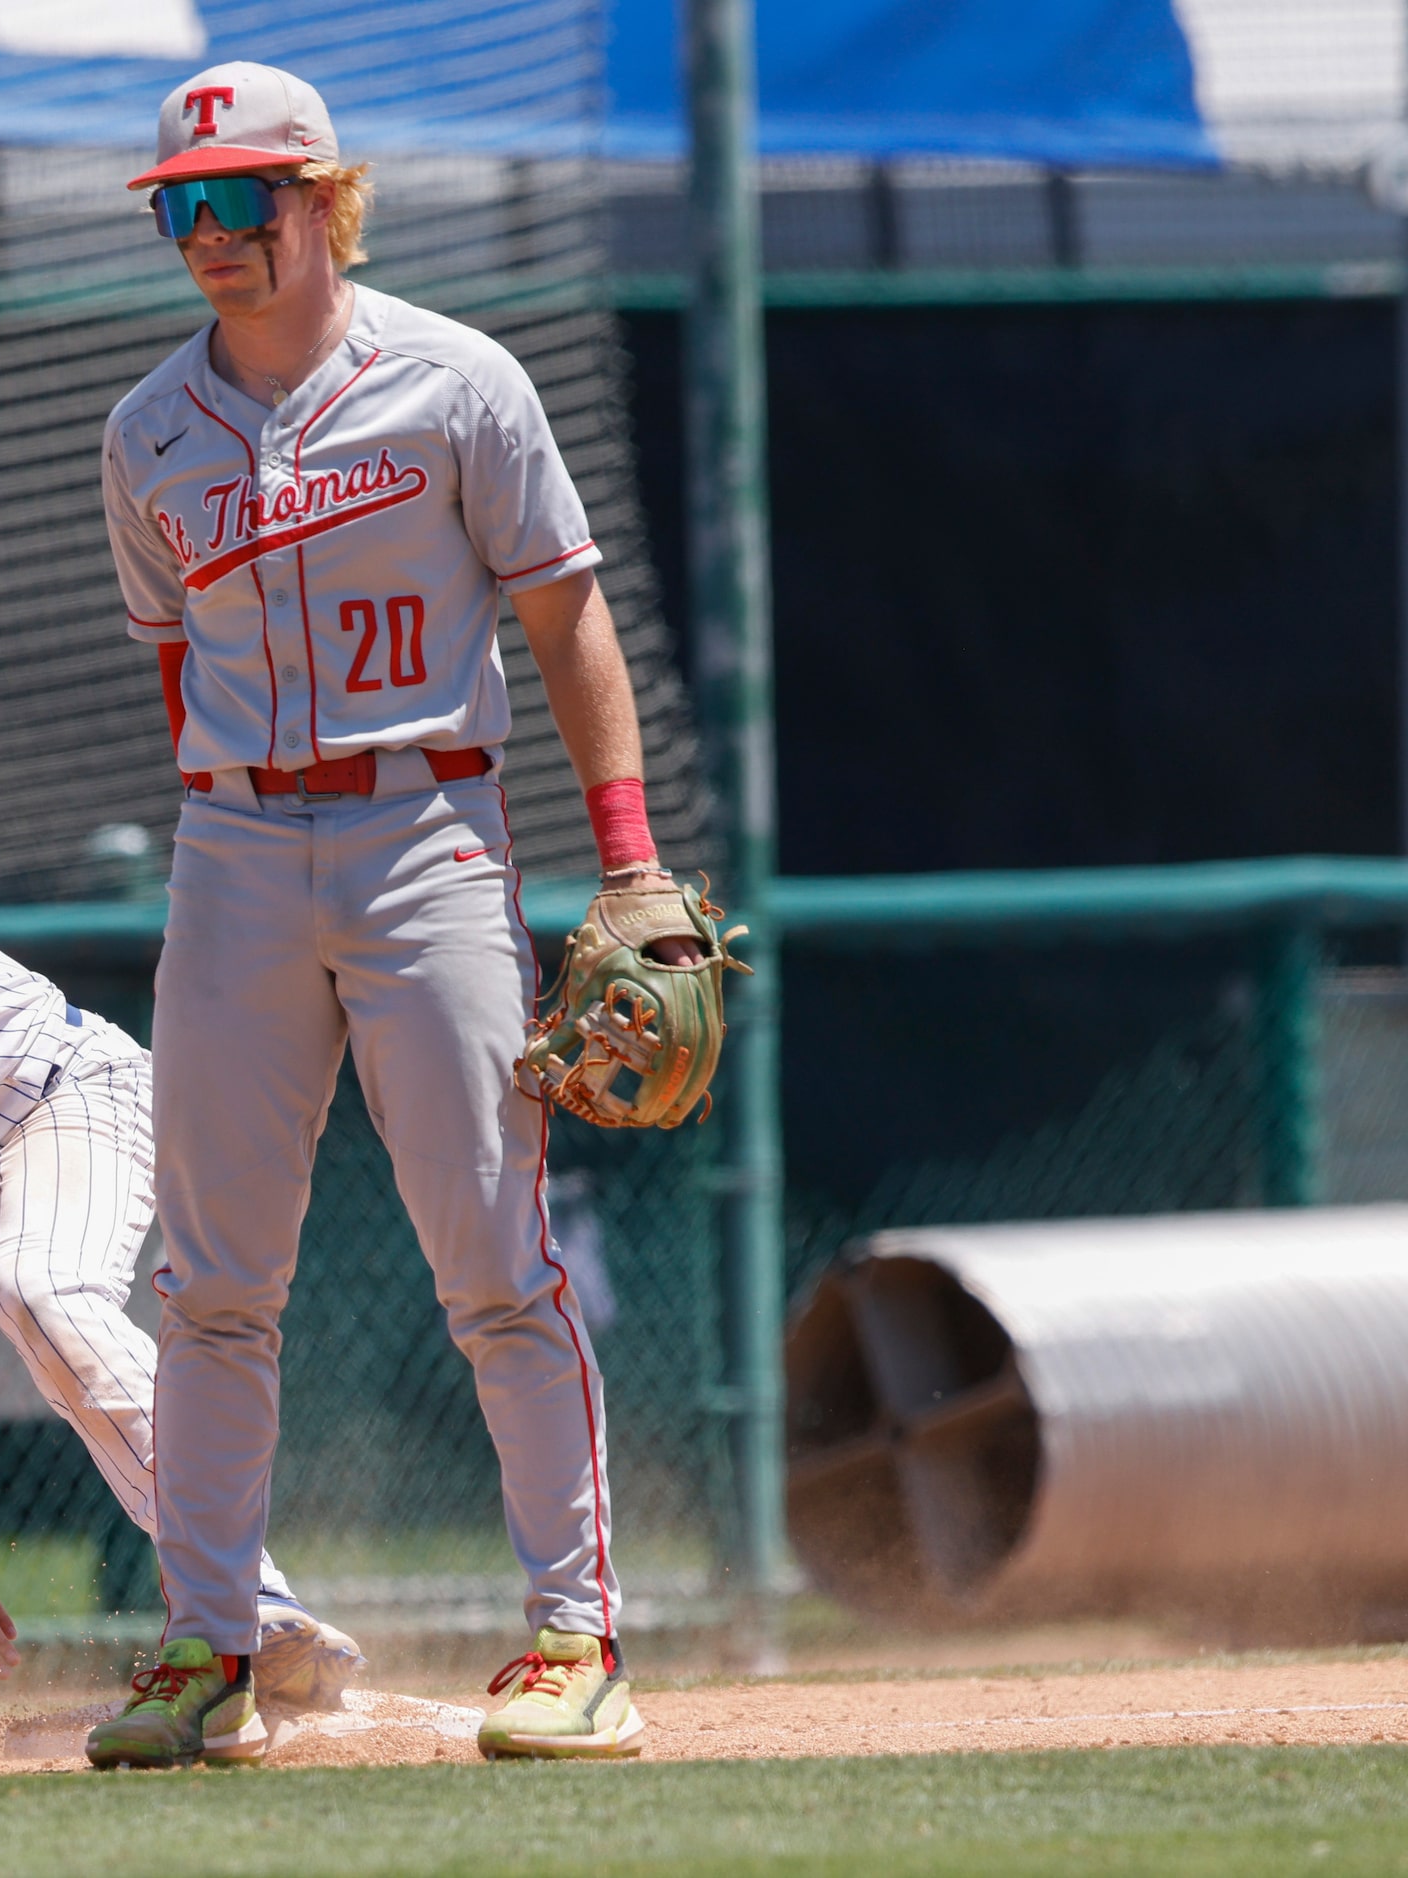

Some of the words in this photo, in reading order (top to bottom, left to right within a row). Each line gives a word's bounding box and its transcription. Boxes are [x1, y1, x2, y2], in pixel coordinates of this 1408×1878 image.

[184, 86, 236, 136] T
[157, 511, 201, 566] St.
[202, 447, 400, 551] Thomas
[339, 594, 427, 693] 20
